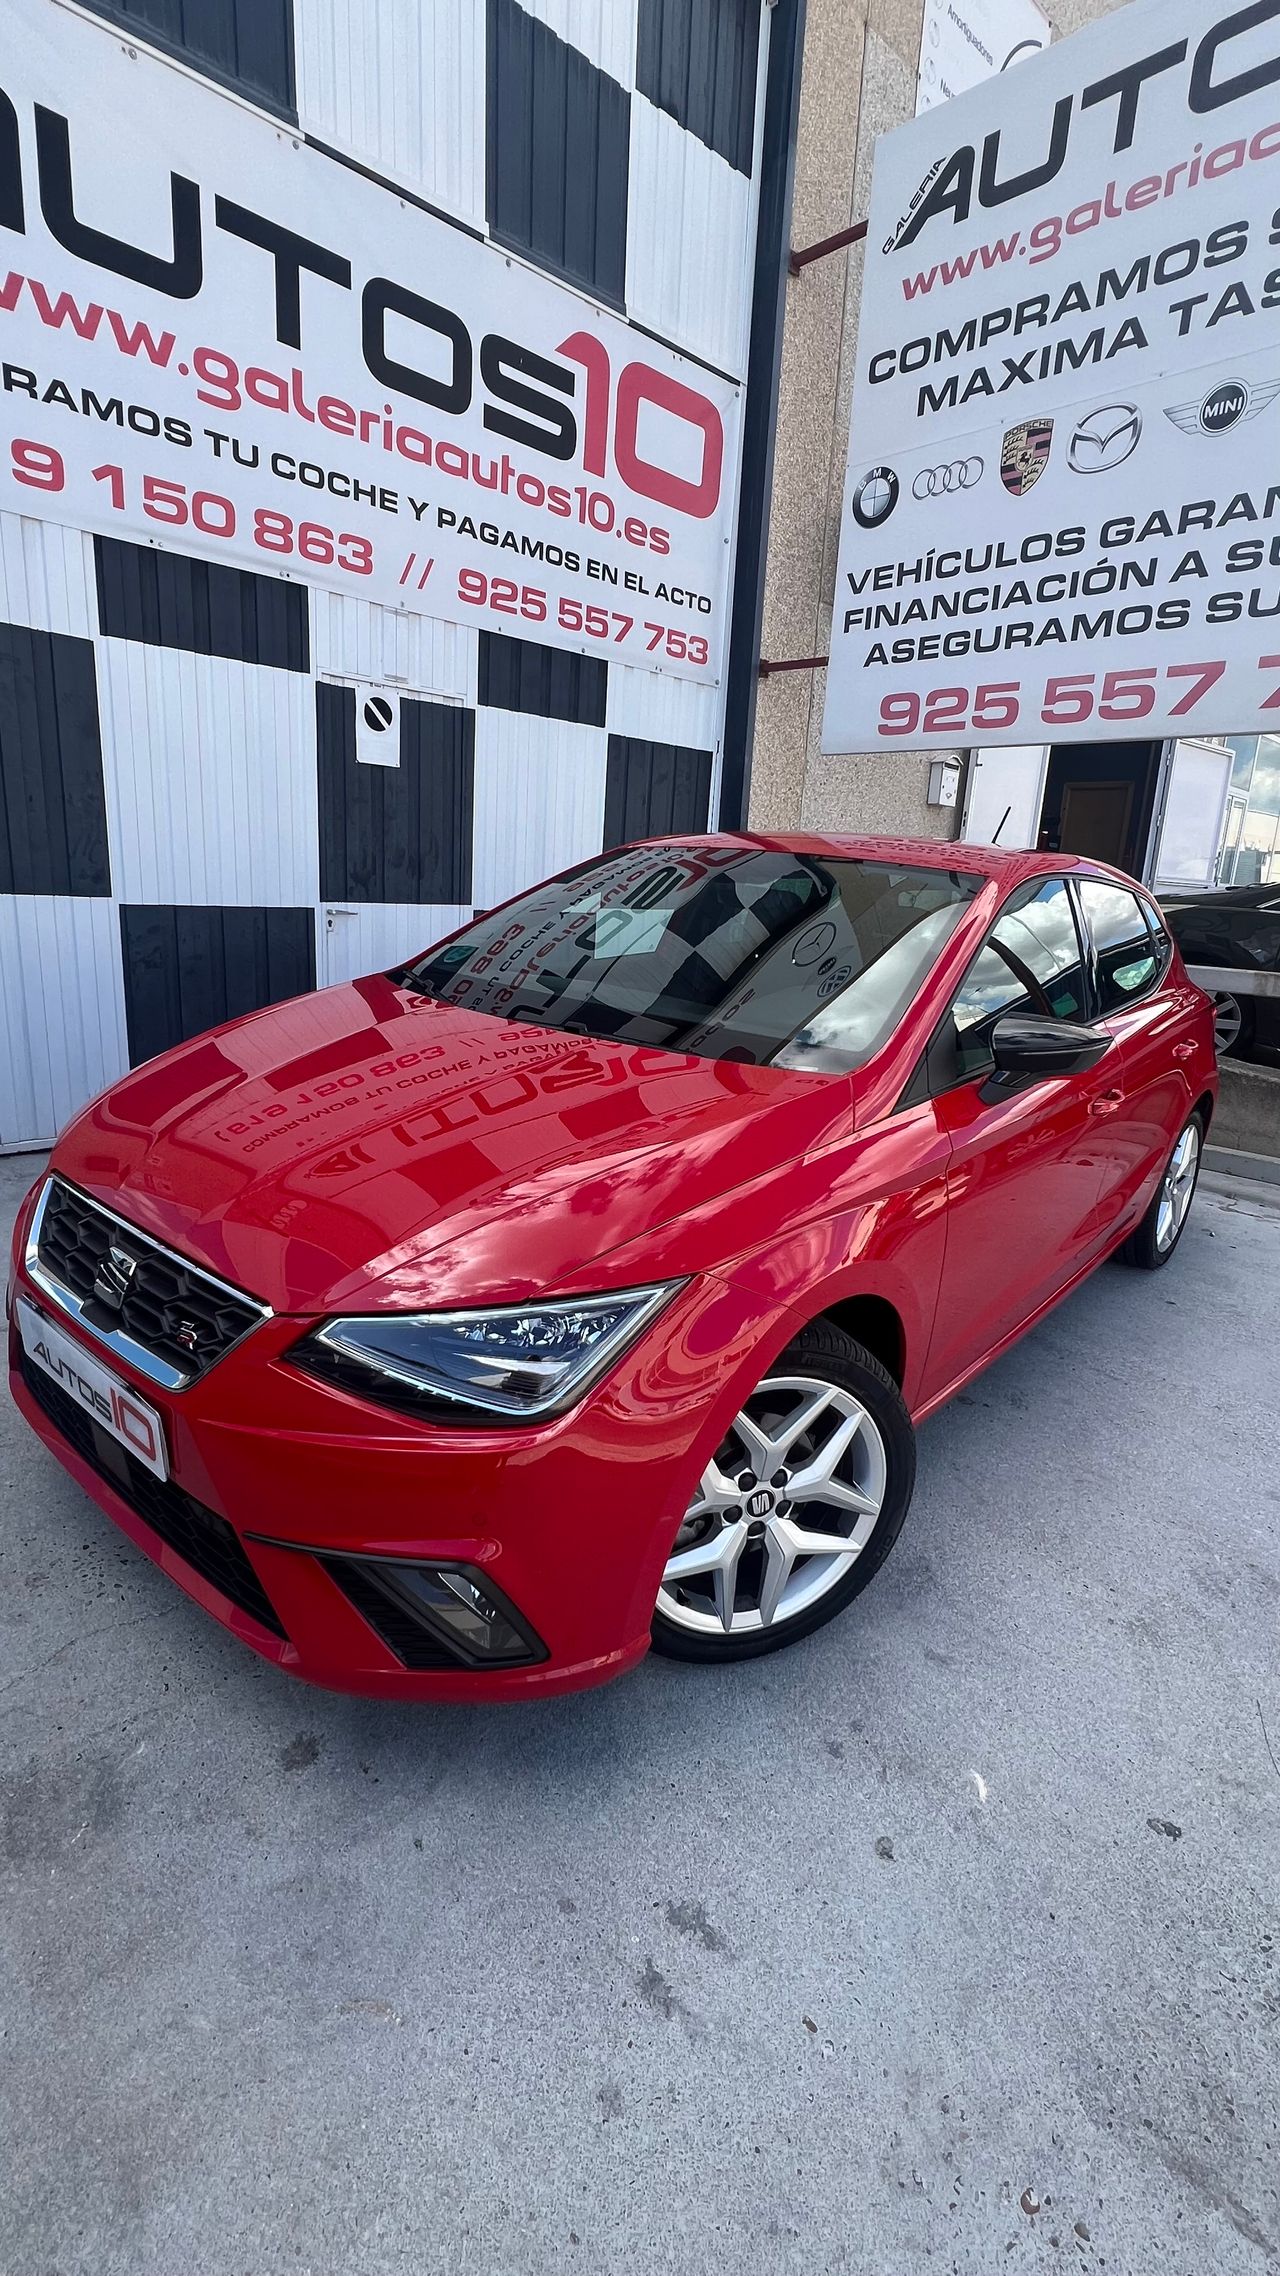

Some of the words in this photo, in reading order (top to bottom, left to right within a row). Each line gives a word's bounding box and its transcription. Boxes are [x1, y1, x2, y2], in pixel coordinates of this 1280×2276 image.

[881, 157, 948, 255] GALERIA
[868, 220, 1249, 385] COMPRAMOS
[916, 316, 1149, 417] MAXIMA
[1203, 396, 1244, 419] MINI
[91, 463, 236, 539] 150
[253, 508, 374, 575] 863
[458, 568, 547, 622] 925
[558, 597, 634, 643] 557
[643, 621, 710, 665] 753
[203, 429, 259, 469] TU
[271, 452, 399, 515] COCHE
[407, 496, 430, 521] Y
[437, 506, 580, 572] PAGAMOS
[586, 557, 619, 585] EN
[624, 574, 650, 596] EL
[654, 581, 712, 615] ACTO
[847, 526, 1086, 595] VEHÍCULOS
[843, 557, 1158, 633] FINANCIACIÓN
[1168, 550, 1209, 583] A
[863, 599, 1191, 667] ASEGURAMOS
[877, 681, 1020, 736] 925
[1041, 660, 1227, 725] 557
[32, 1341, 157, 1463] AUTOS10
